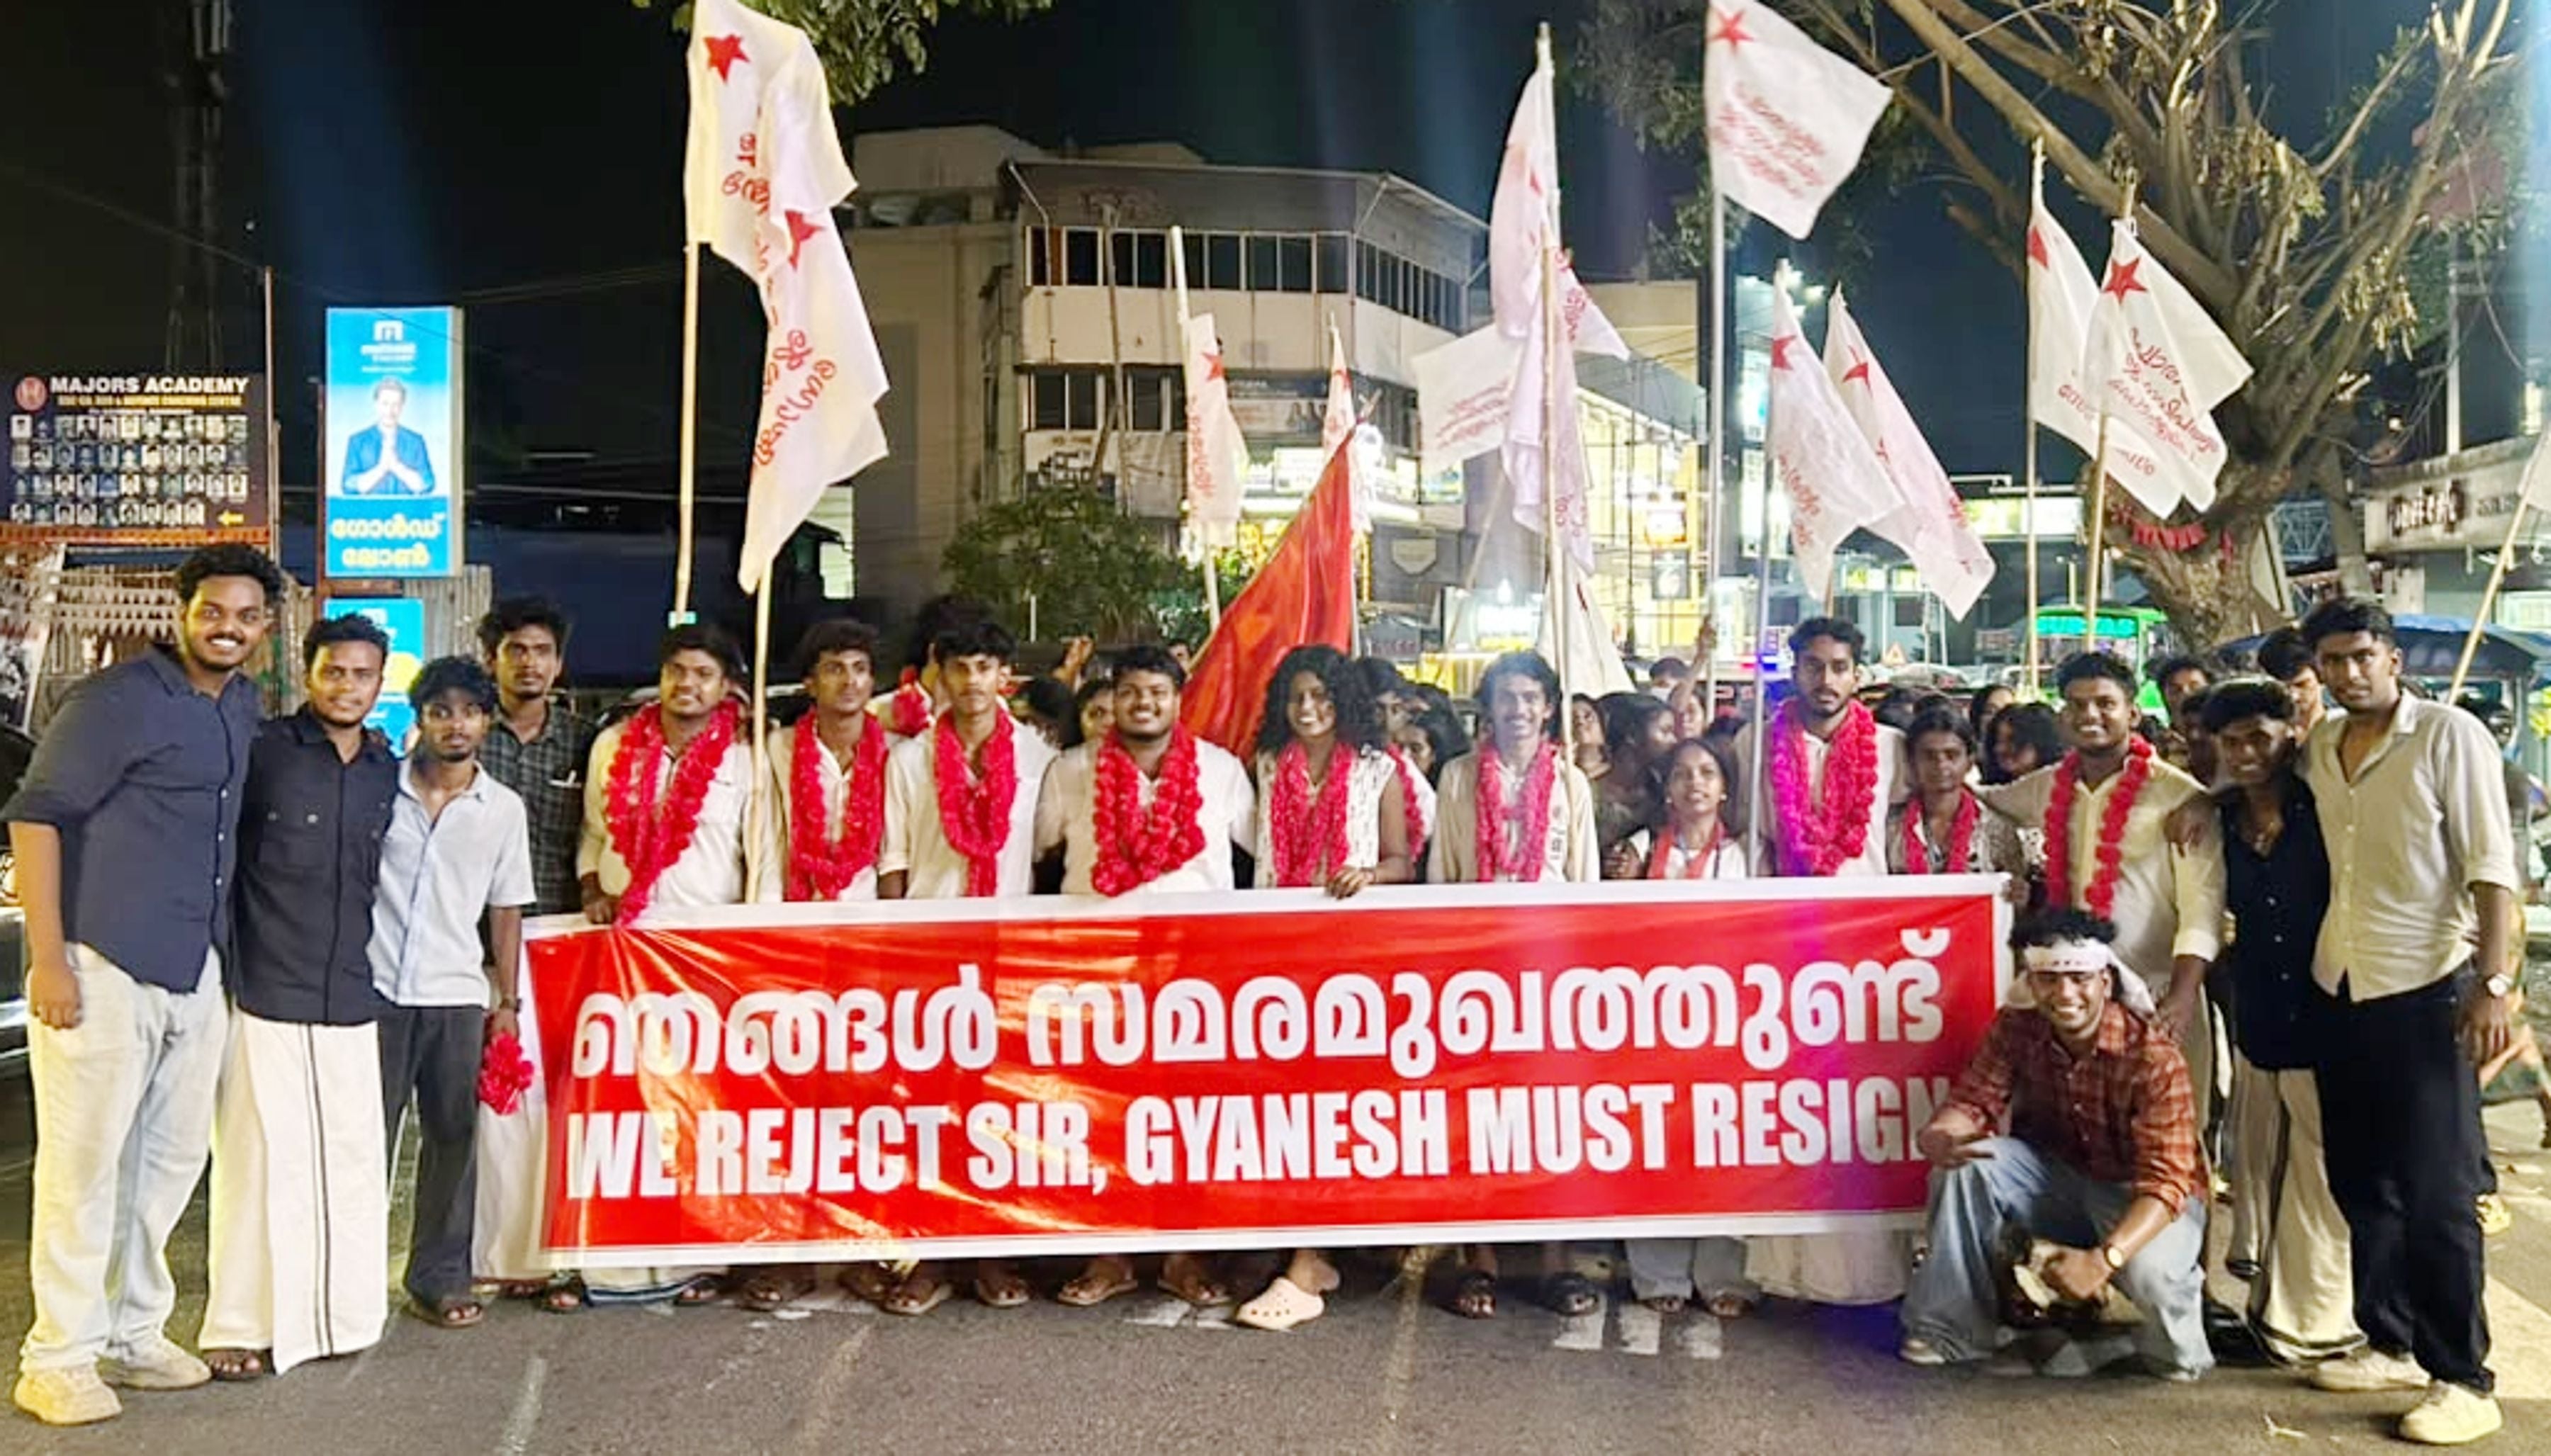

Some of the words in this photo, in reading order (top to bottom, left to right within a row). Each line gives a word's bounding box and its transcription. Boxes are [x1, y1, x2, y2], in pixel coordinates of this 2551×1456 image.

[51, 377, 140, 393] MAJORS
[145, 377, 248, 393] ACADEMY
[573, 964, 998, 1076] ഞങ്ങൾ
[1029, 928, 1949, 1078] സമരമുഖത്തുണ്ട്
[567, 1112, 675, 1199] WE
[697, 1106, 949, 1197] REJECT
[967, 1102, 1107, 1195] SIR,
[1125, 1089, 1447, 1185] GYANESH
[1468, 1083, 1674, 1173] MUST
